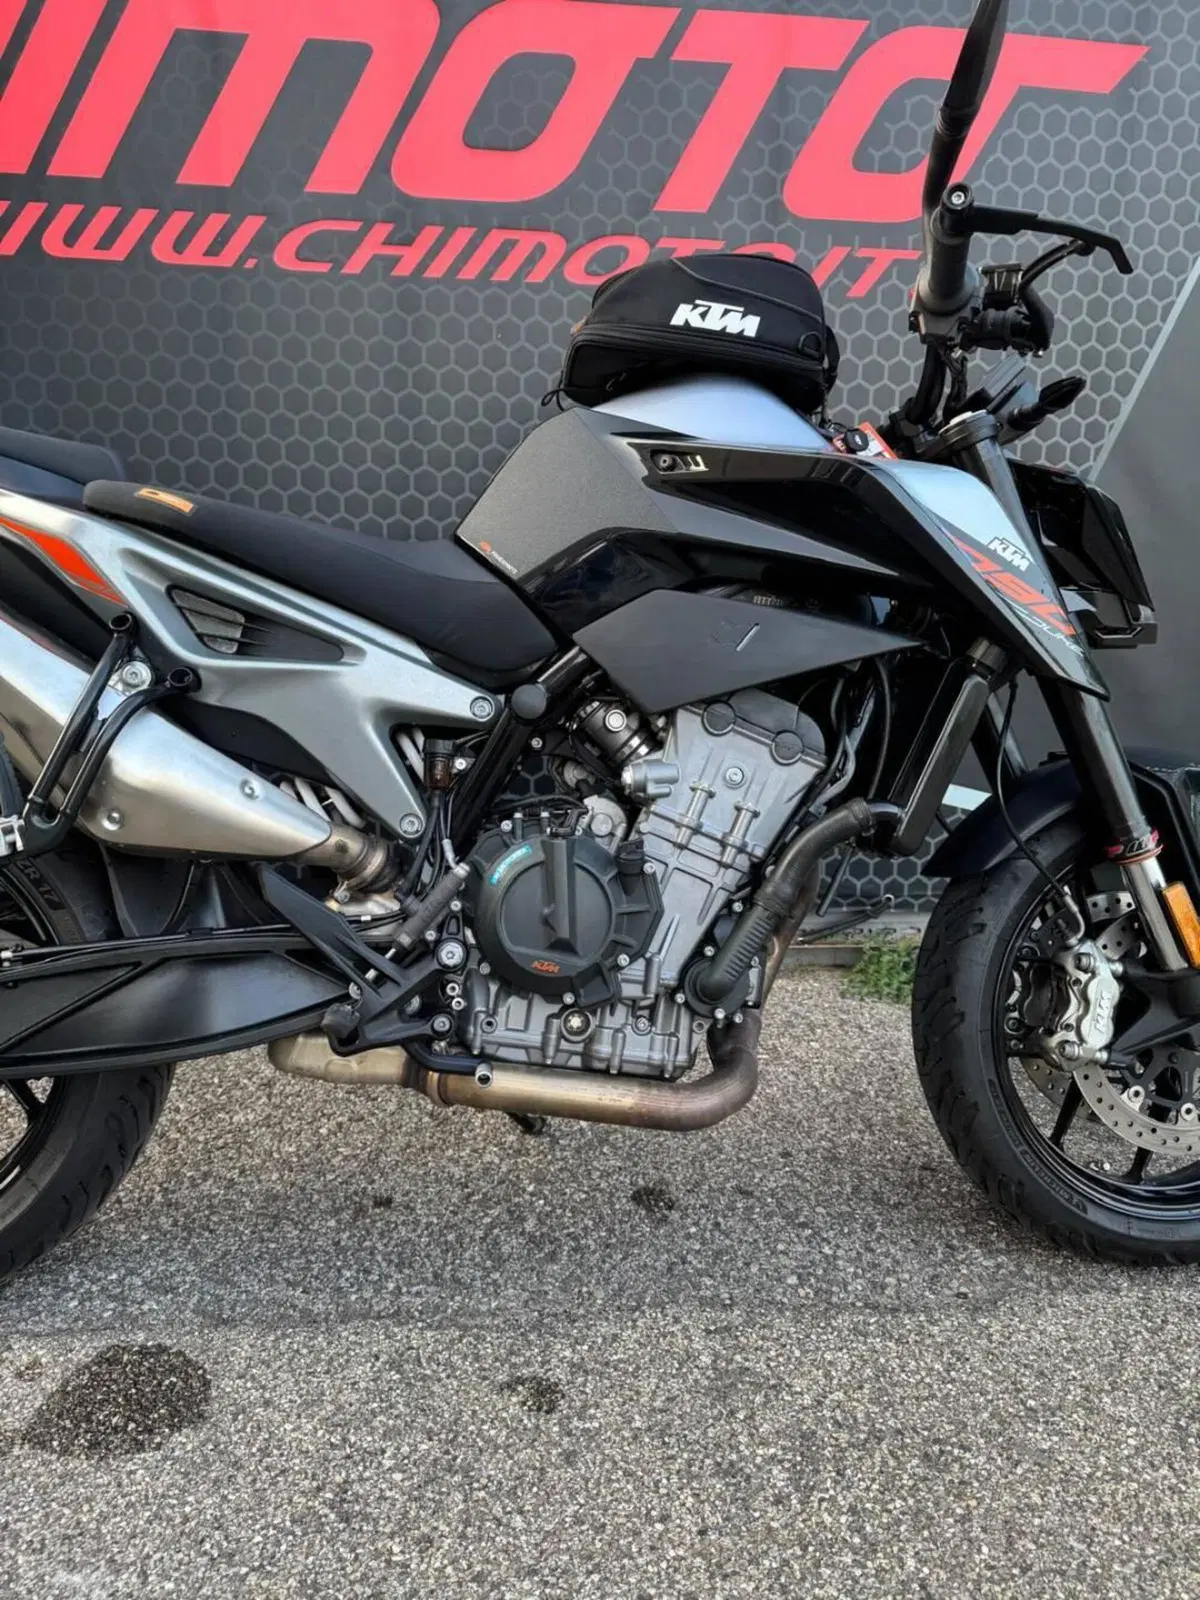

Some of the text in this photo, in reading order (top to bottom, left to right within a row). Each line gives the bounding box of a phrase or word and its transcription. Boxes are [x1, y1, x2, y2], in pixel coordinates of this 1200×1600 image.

[0, 0, 1150, 223] IMOTO
[669, 299, 761, 338] KTM
[987, 537, 1031, 572] KTM
[530, 959, 560, 974] KTM
